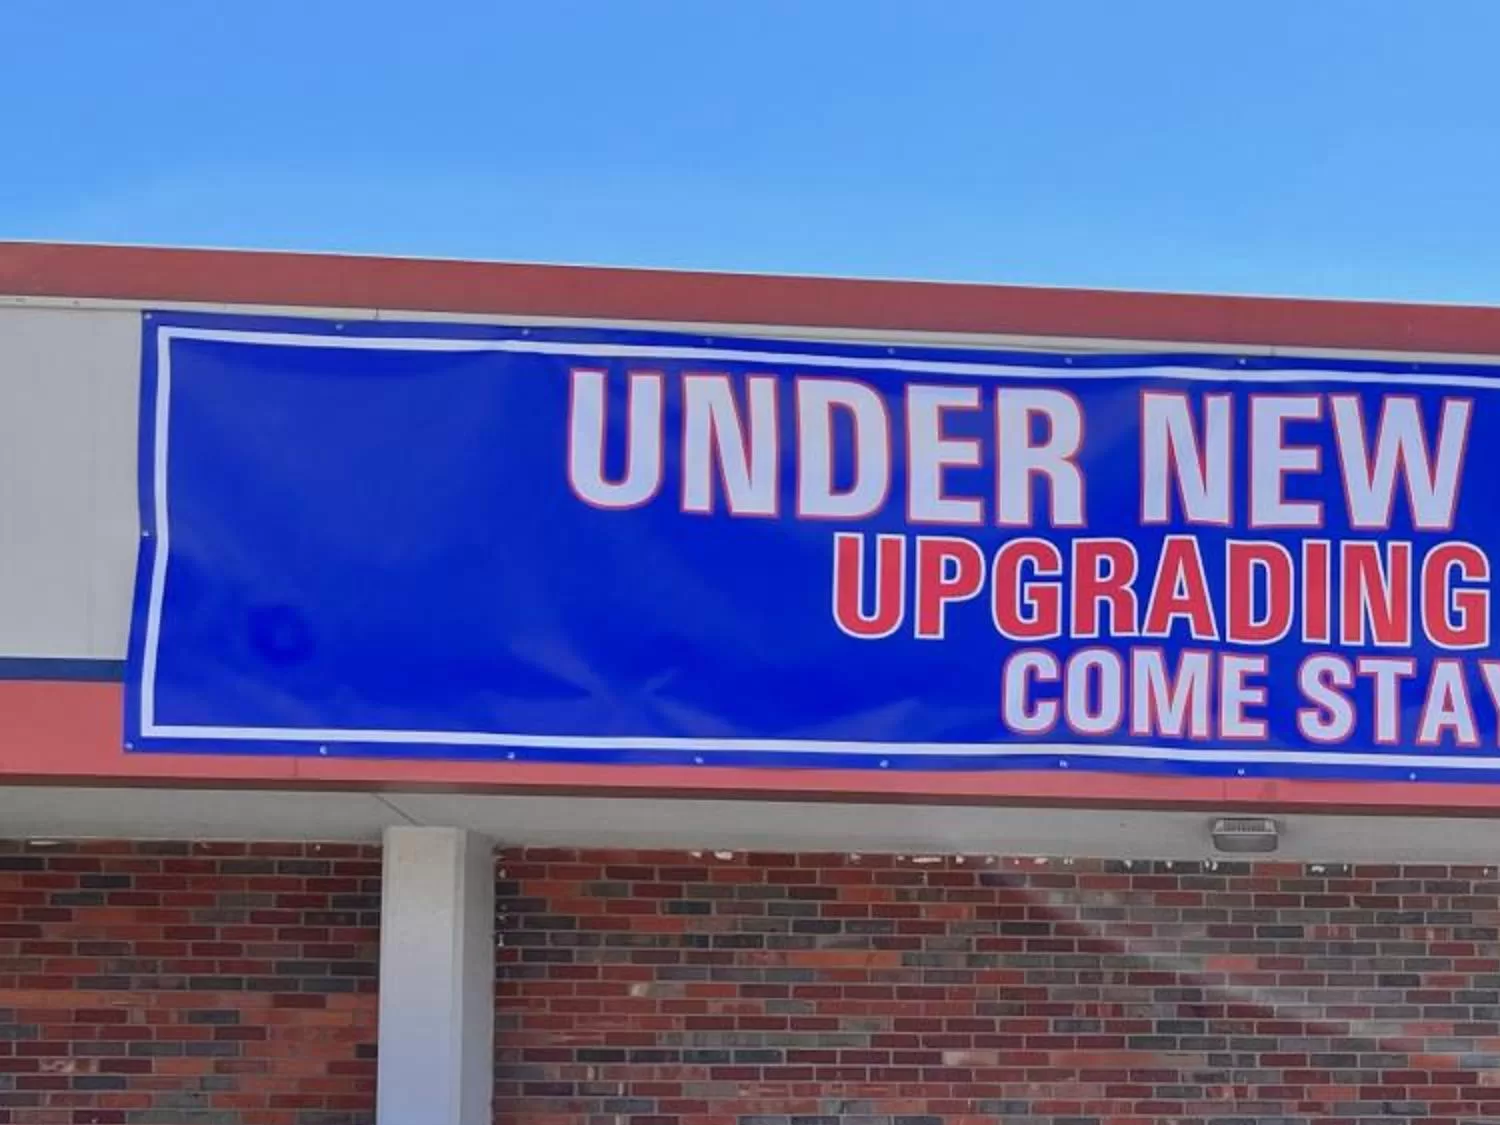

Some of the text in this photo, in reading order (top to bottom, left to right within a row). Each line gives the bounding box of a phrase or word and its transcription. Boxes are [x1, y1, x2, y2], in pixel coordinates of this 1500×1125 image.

[566, 369, 1086, 528] UNDER
[1139, 389, 1473, 532] NEW
[831, 531, 1492, 651] UPGRADING
[1002, 648, 1269, 742] COME
